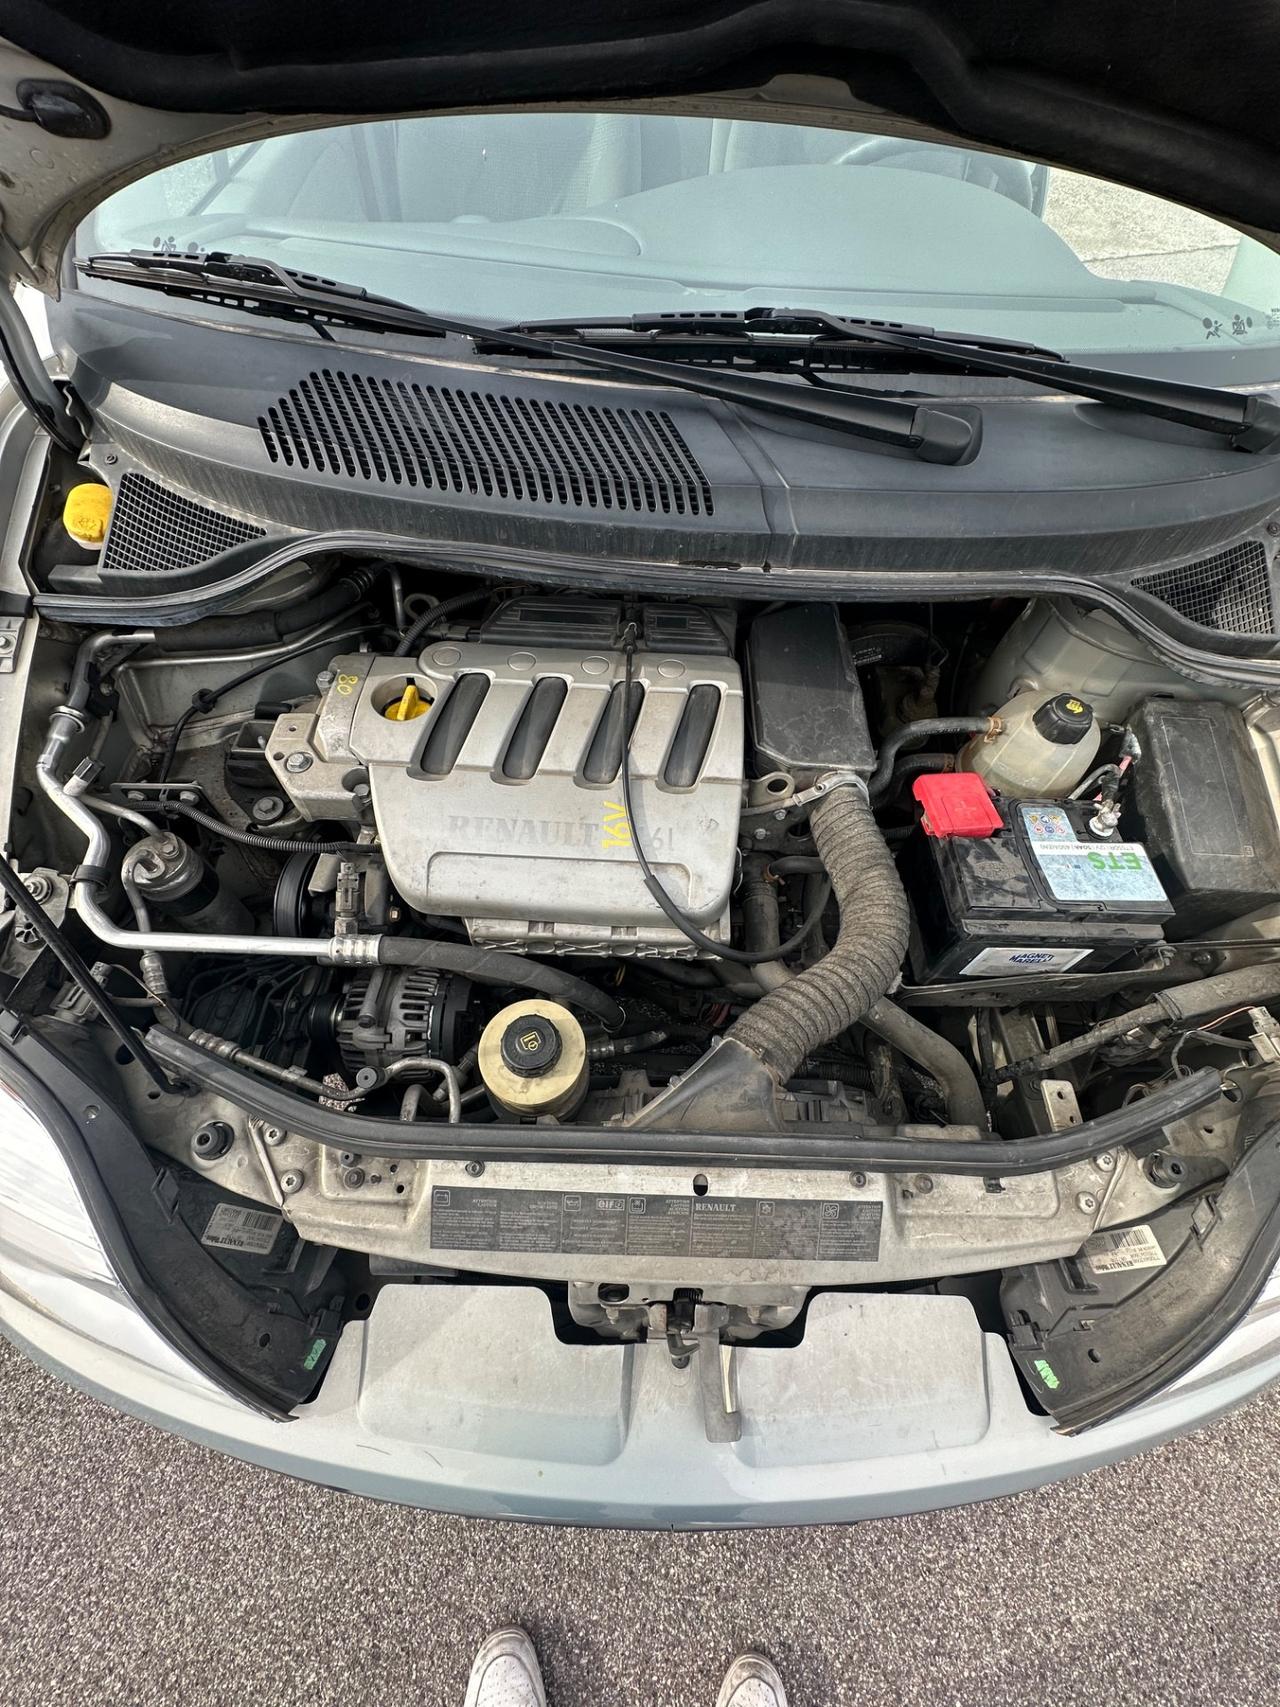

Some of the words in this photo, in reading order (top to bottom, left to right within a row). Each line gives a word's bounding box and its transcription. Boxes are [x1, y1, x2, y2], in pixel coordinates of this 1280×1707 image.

[448, 815, 600, 848] RENAULT
[601, 800, 632, 849] 16V
[1088, 851, 1142, 870] ETS
[695, 1203, 736, 1212] RENAULT
[1109, 1260, 1134, 1270] RENAULT
